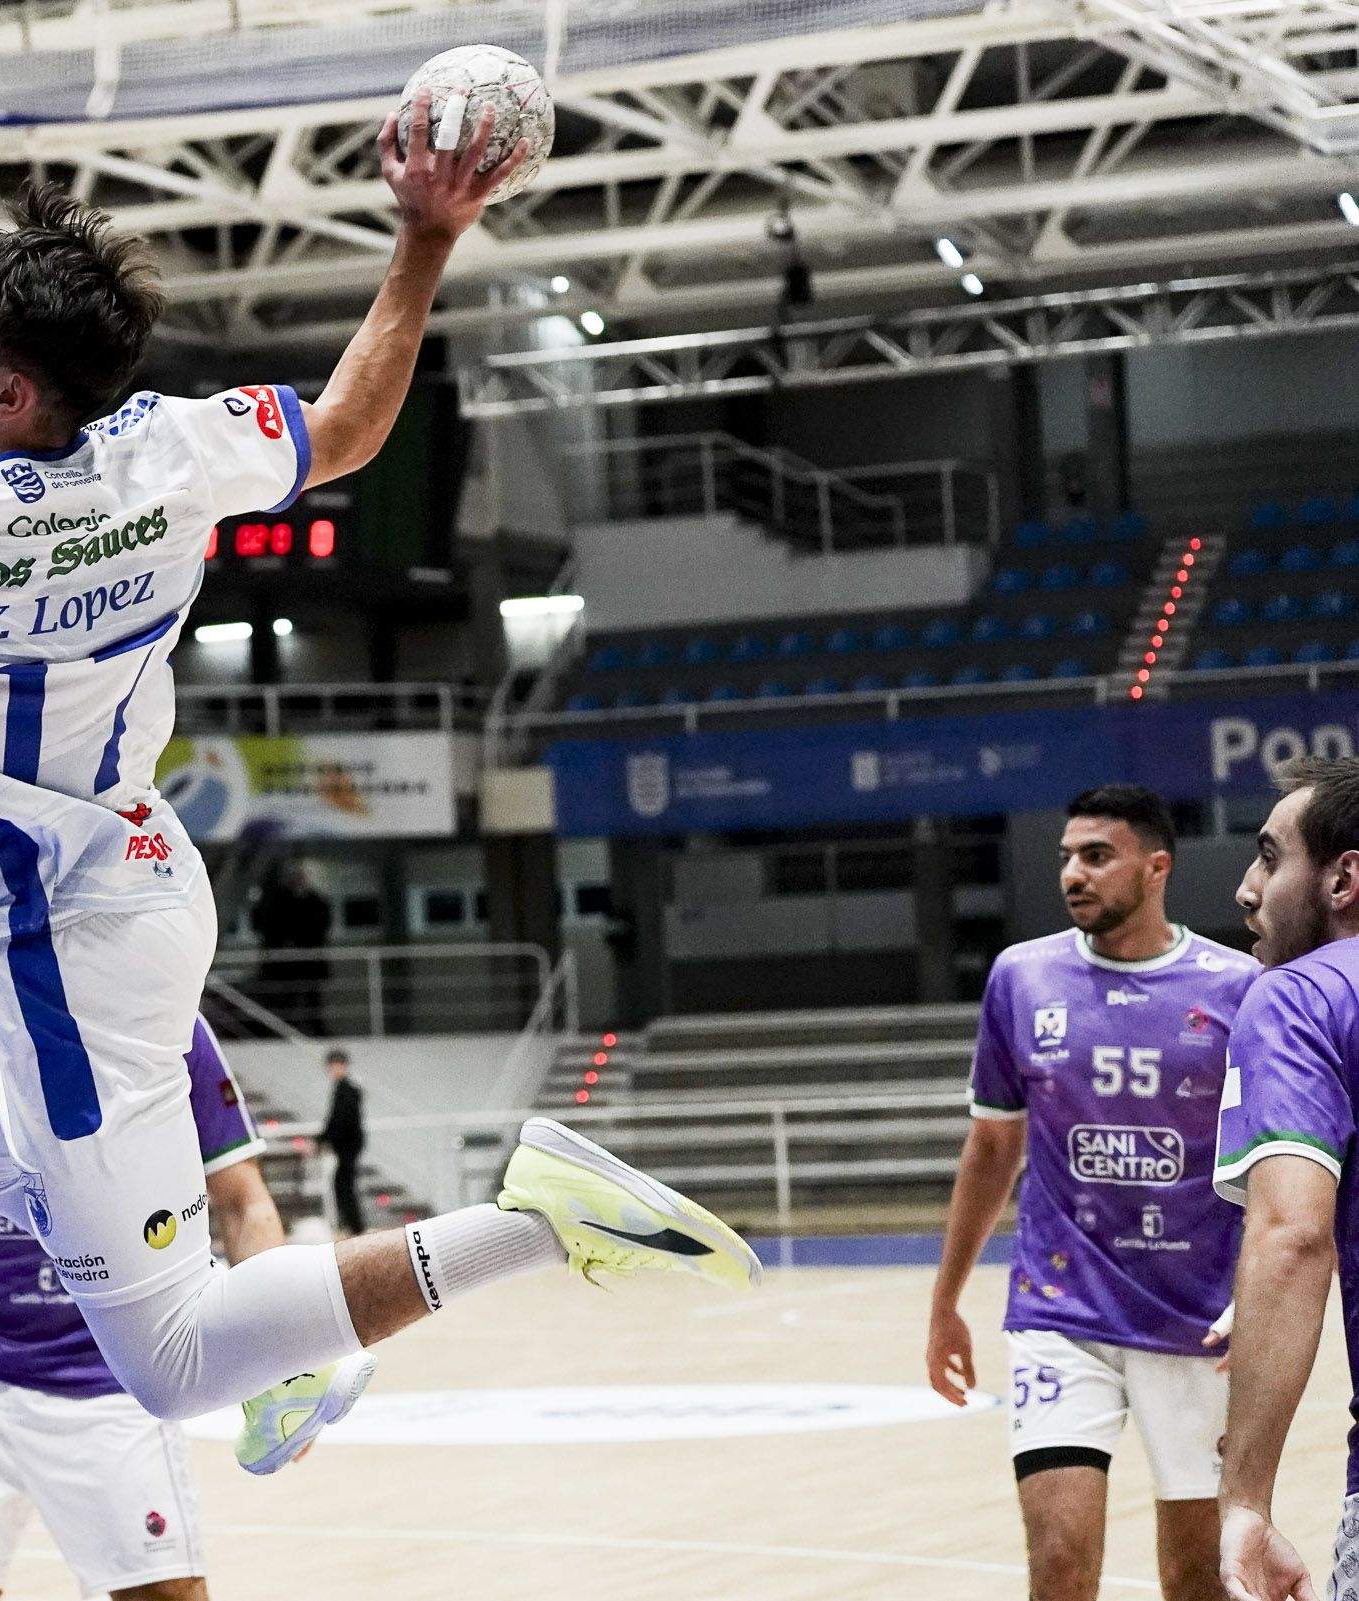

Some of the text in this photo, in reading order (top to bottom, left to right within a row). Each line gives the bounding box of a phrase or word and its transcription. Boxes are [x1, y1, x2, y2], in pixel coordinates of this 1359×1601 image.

[44, 470, 82, 479] Concello
[51, 480, 63, 489] de
[47, 505, 168, 580] Sauces
[28, 571, 155, 636] Lopez
[1092, 1045, 1163, 1098] 55
[1077, 1132, 1136, 1155] SANI
[1078, 1155, 1177, 1180] CENTRO
